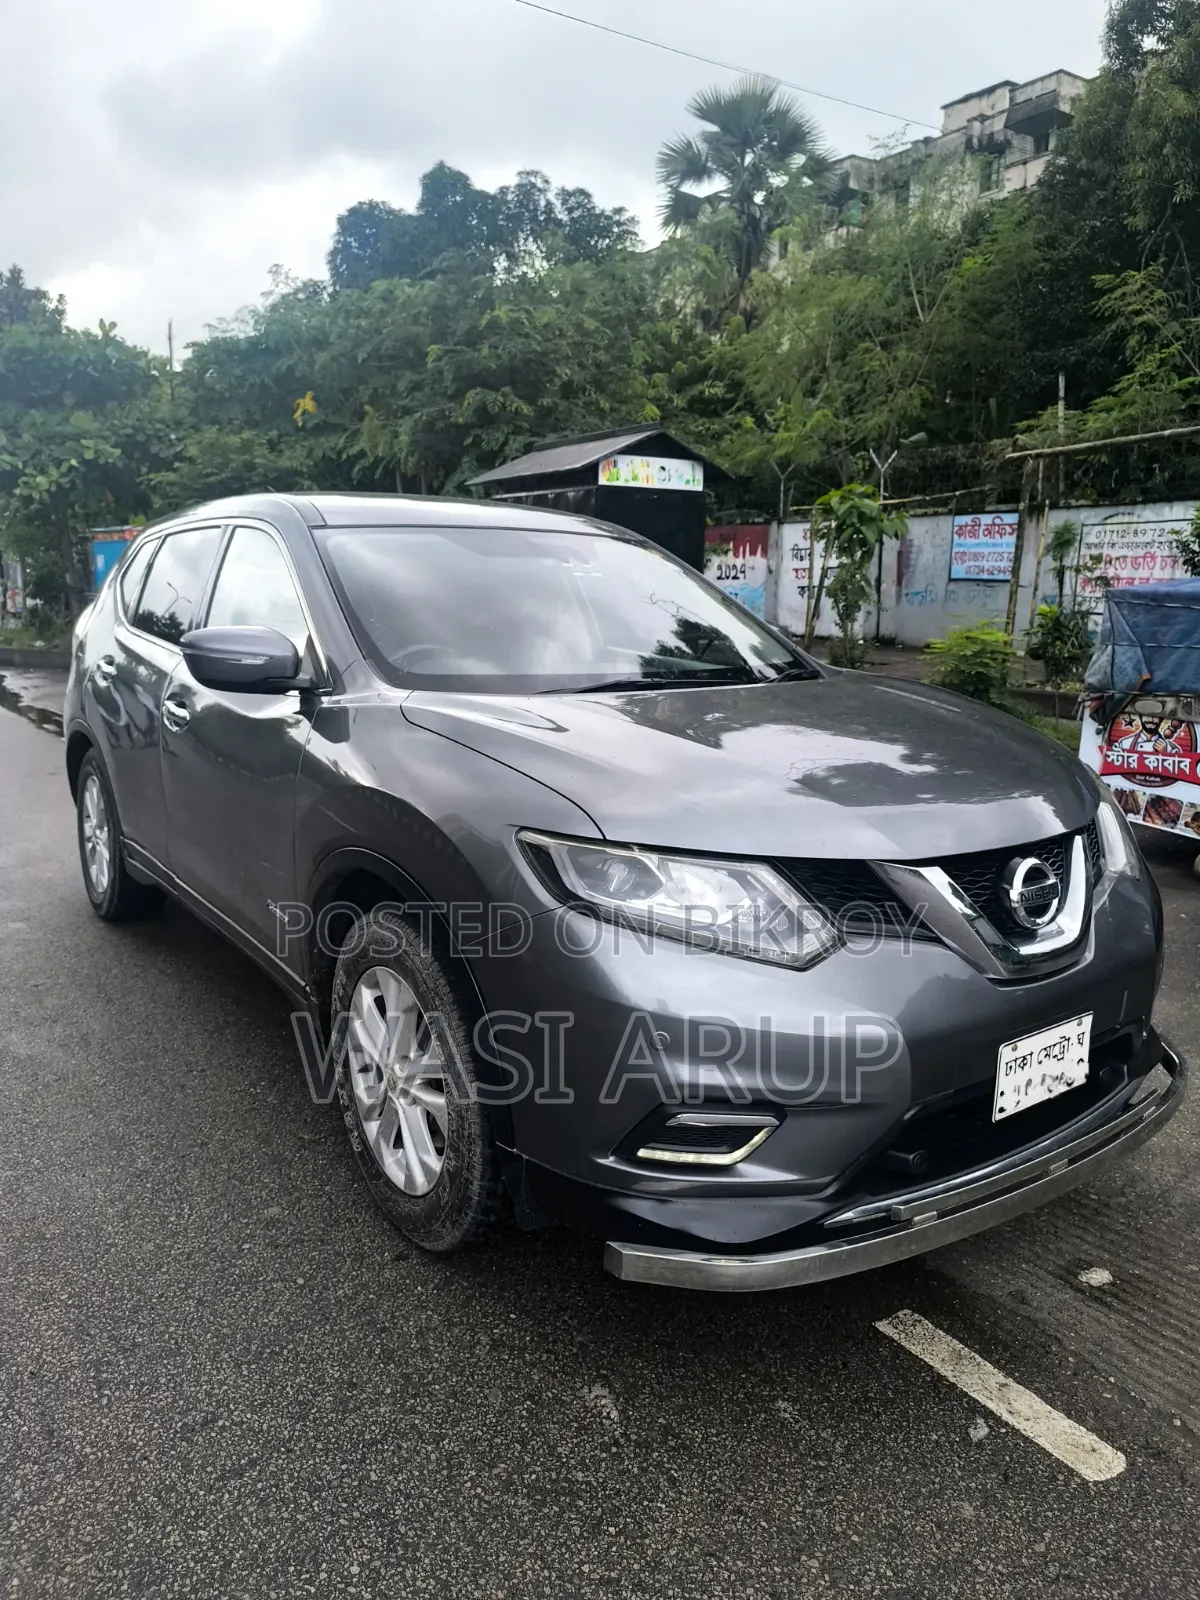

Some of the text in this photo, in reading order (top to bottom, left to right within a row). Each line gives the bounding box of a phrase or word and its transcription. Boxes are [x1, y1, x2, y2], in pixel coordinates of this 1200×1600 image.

[1105, 742, 1139, 769] স্টার
[1143, 753, 1192, 776] কাবাব
[1005, 1051, 1034, 1076] ঢাকা
